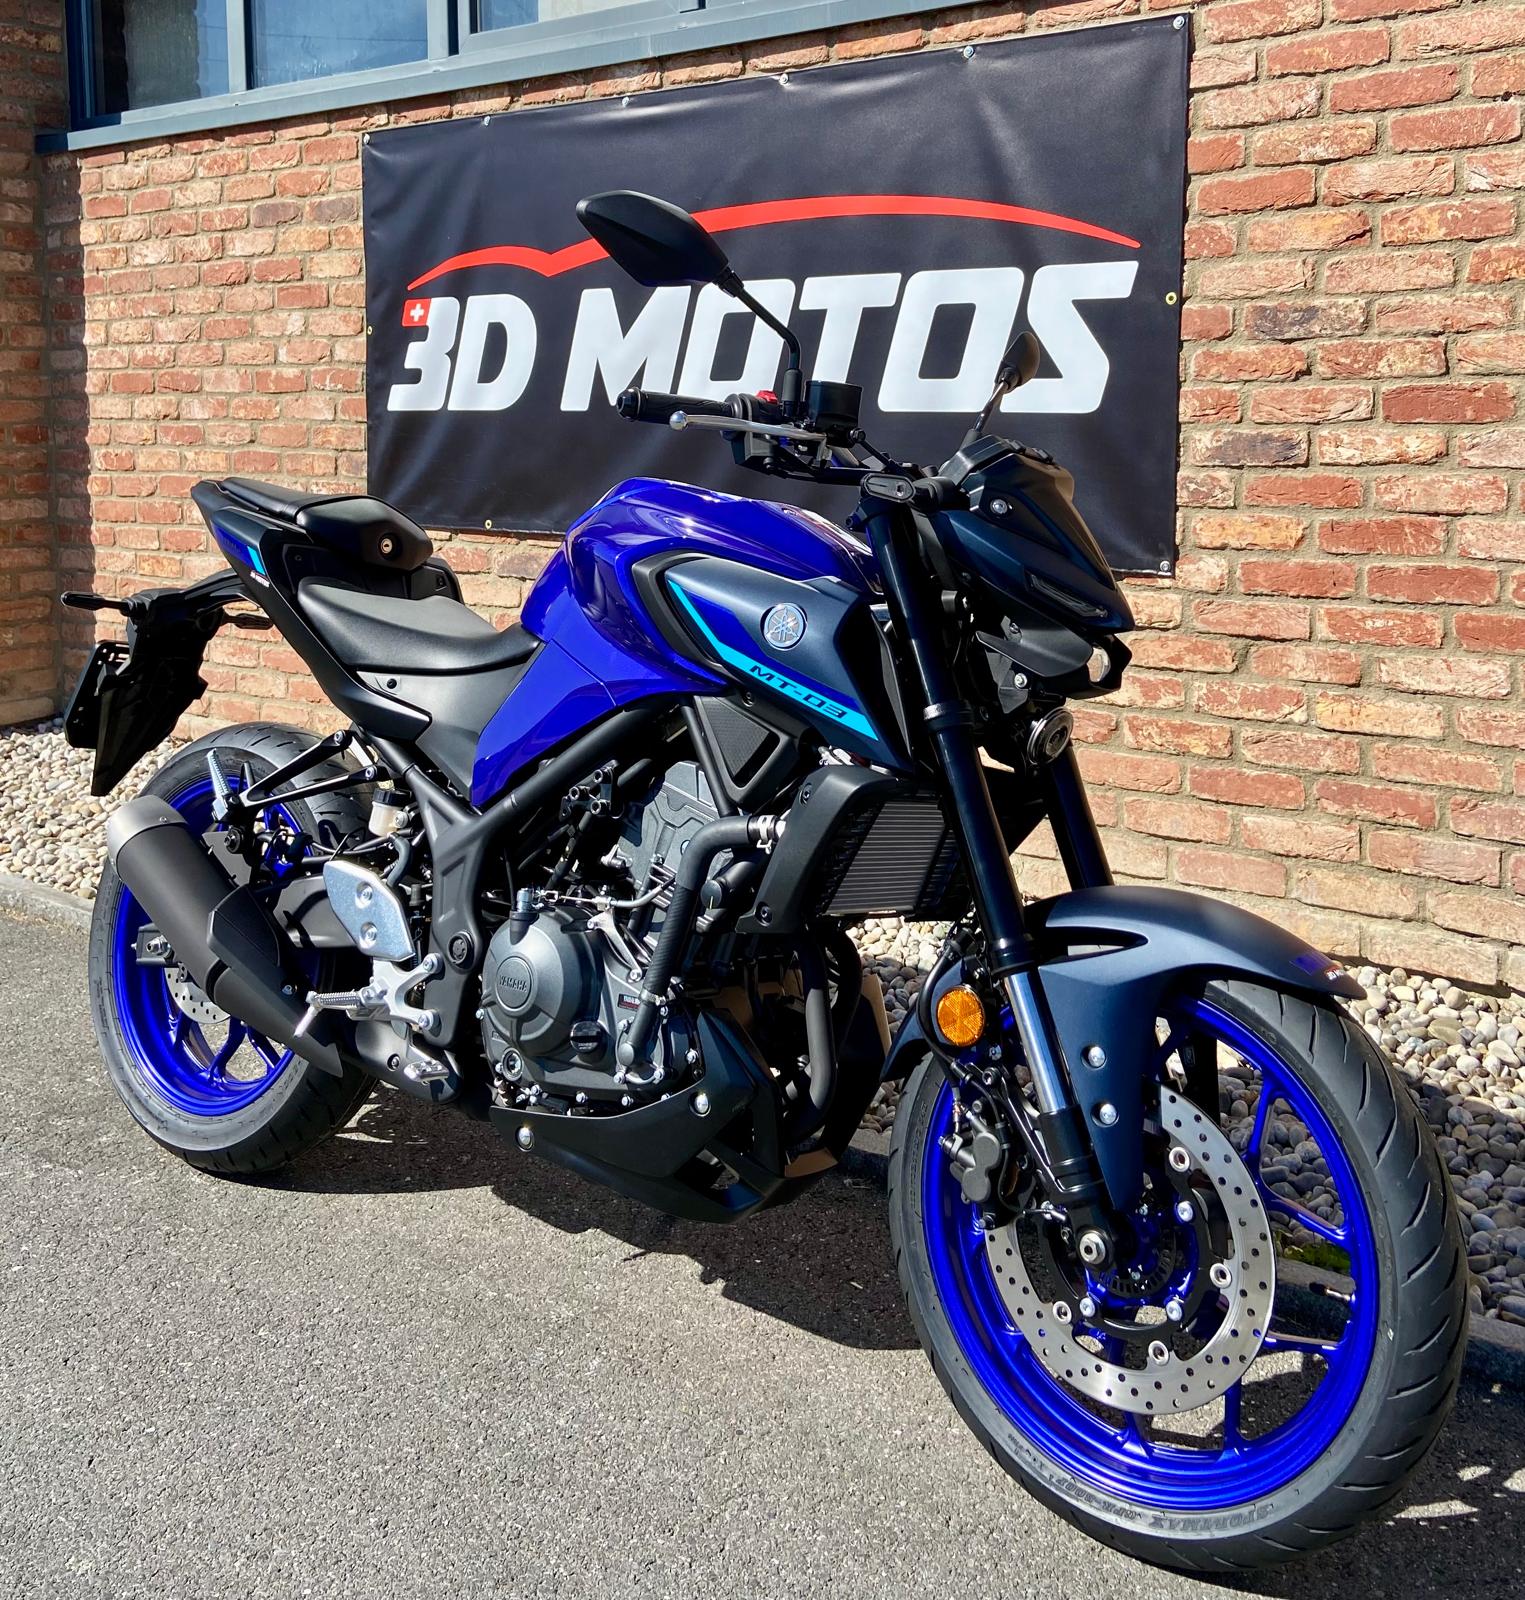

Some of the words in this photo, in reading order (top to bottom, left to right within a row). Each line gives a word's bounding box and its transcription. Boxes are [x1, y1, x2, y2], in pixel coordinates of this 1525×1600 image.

[387, 293, 538, 412] 3D
[560, 261, 1140, 413] MOTOS
[750, 664, 848, 719] MT-03
